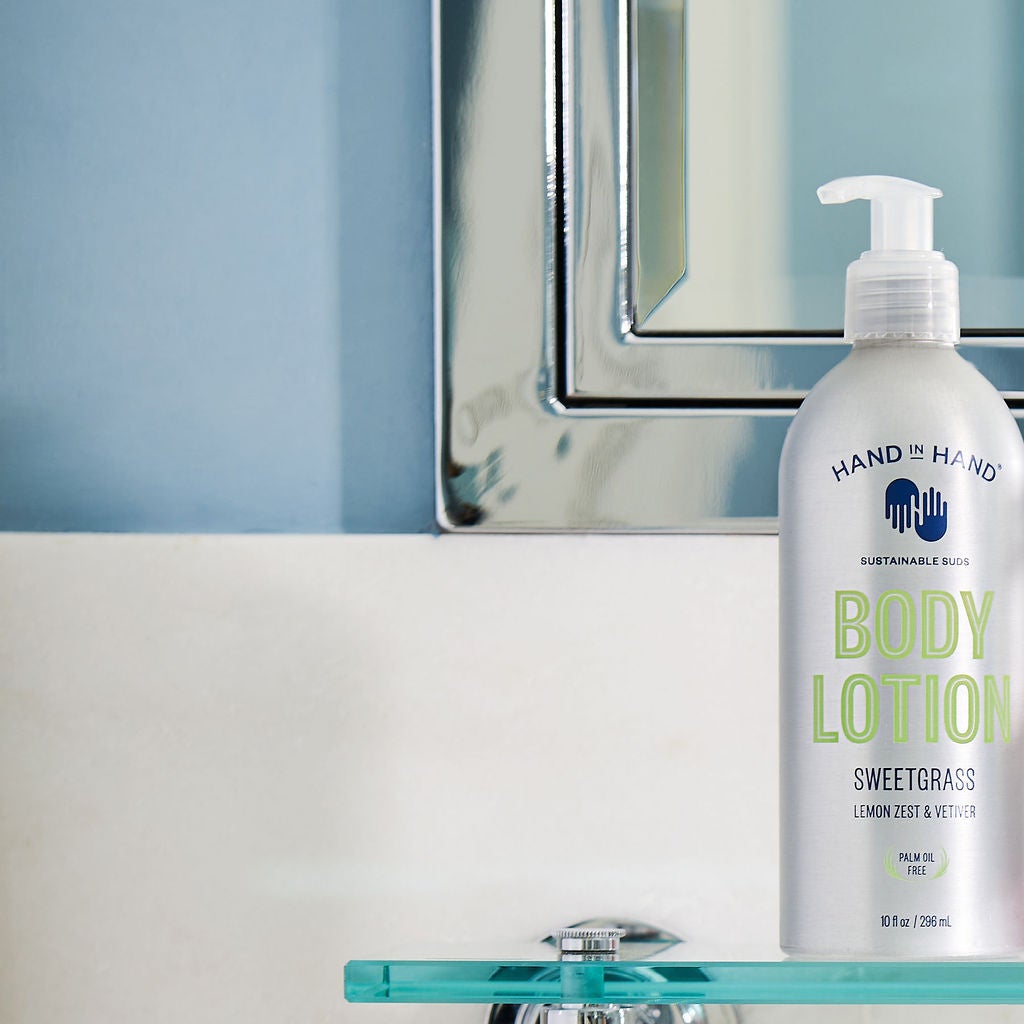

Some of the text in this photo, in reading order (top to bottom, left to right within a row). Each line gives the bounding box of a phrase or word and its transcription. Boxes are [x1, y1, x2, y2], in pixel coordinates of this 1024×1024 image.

[831, 445, 903, 482] HAND
[909, 444, 924, 455] IN
[860, 556, 970, 566] SUSTAINABLE SUDS
[834, 589, 995, 660] BODY
[813, 673, 1011, 744] LOTION
[854, 767, 975, 791] SWEETGRASS
[854, 804, 976, 819] LEMON ZEST & VETIVER
[899, 852, 935, 863] PALM OIL
[907, 865, 927, 876] FREE
[880, 914, 952, 929] 10 fl oz / 296 mL
